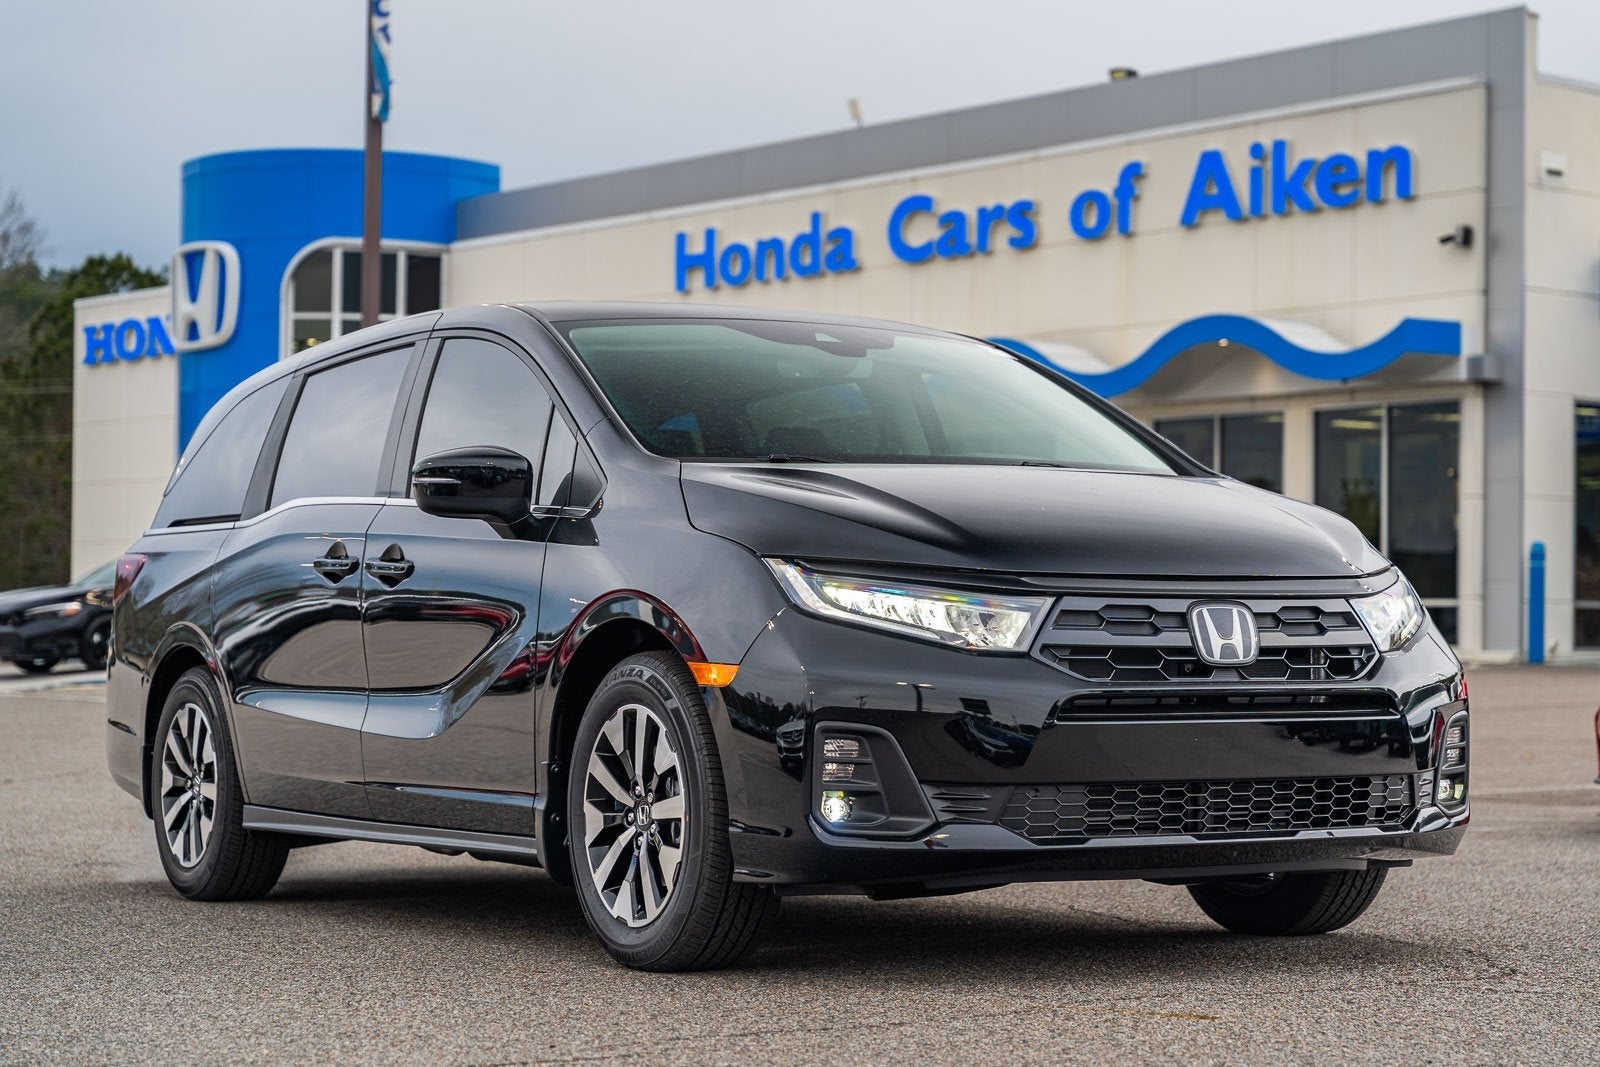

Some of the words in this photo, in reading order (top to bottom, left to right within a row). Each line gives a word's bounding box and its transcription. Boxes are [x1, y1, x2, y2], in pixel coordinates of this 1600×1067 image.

[674, 211, 858, 292] Honda
[887, 194, 1036, 263] Cars
[1068, 161, 1143, 240] of
[1180, 139, 1412, 227] Aiken
[83, 316, 176, 366] HON
